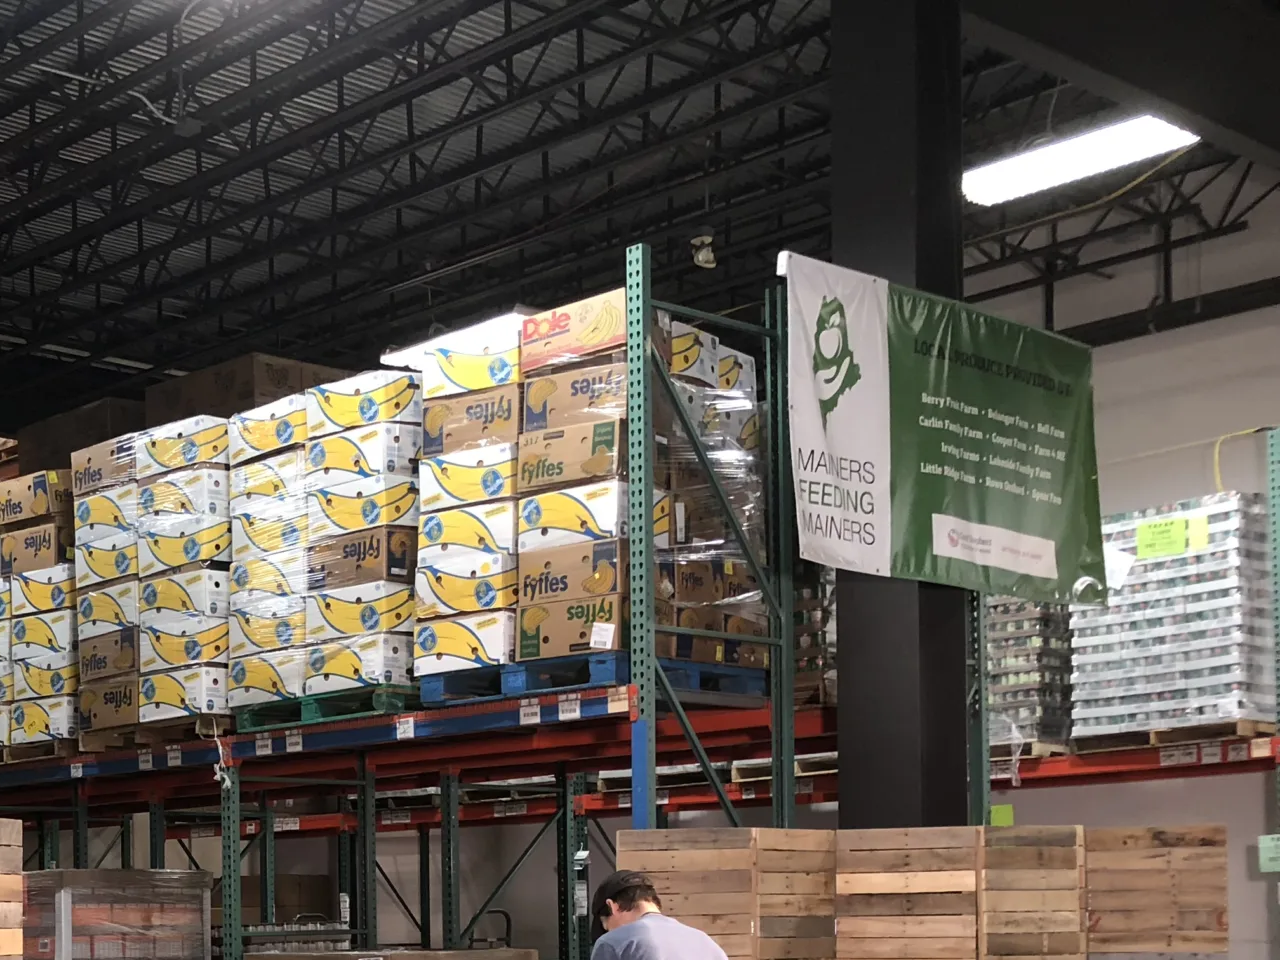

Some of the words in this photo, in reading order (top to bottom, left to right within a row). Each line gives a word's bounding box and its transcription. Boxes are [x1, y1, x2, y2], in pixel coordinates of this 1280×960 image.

[522, 310, 571, 341] Dole
[465, 395, 512, 425] Fyffes
[74, 467, 103, 491] Fyffes
[521, 458, 565, 485] Fyffes
[798, 447, 876, 485] MAINERS
[799, 479, 876, 515] FEEDING
[24, 529, 52, 551] Fyffes
[801, 509, 876, 546] MAINERS
[343, 535, 381, 563] Fyffes
[523, 571, 569, 602] Fyffes
[566, 597, 613, 622] Fyffes
[81, 655, 108, 677] Fyffes
[103, 685, 133, 709] Fyffes
